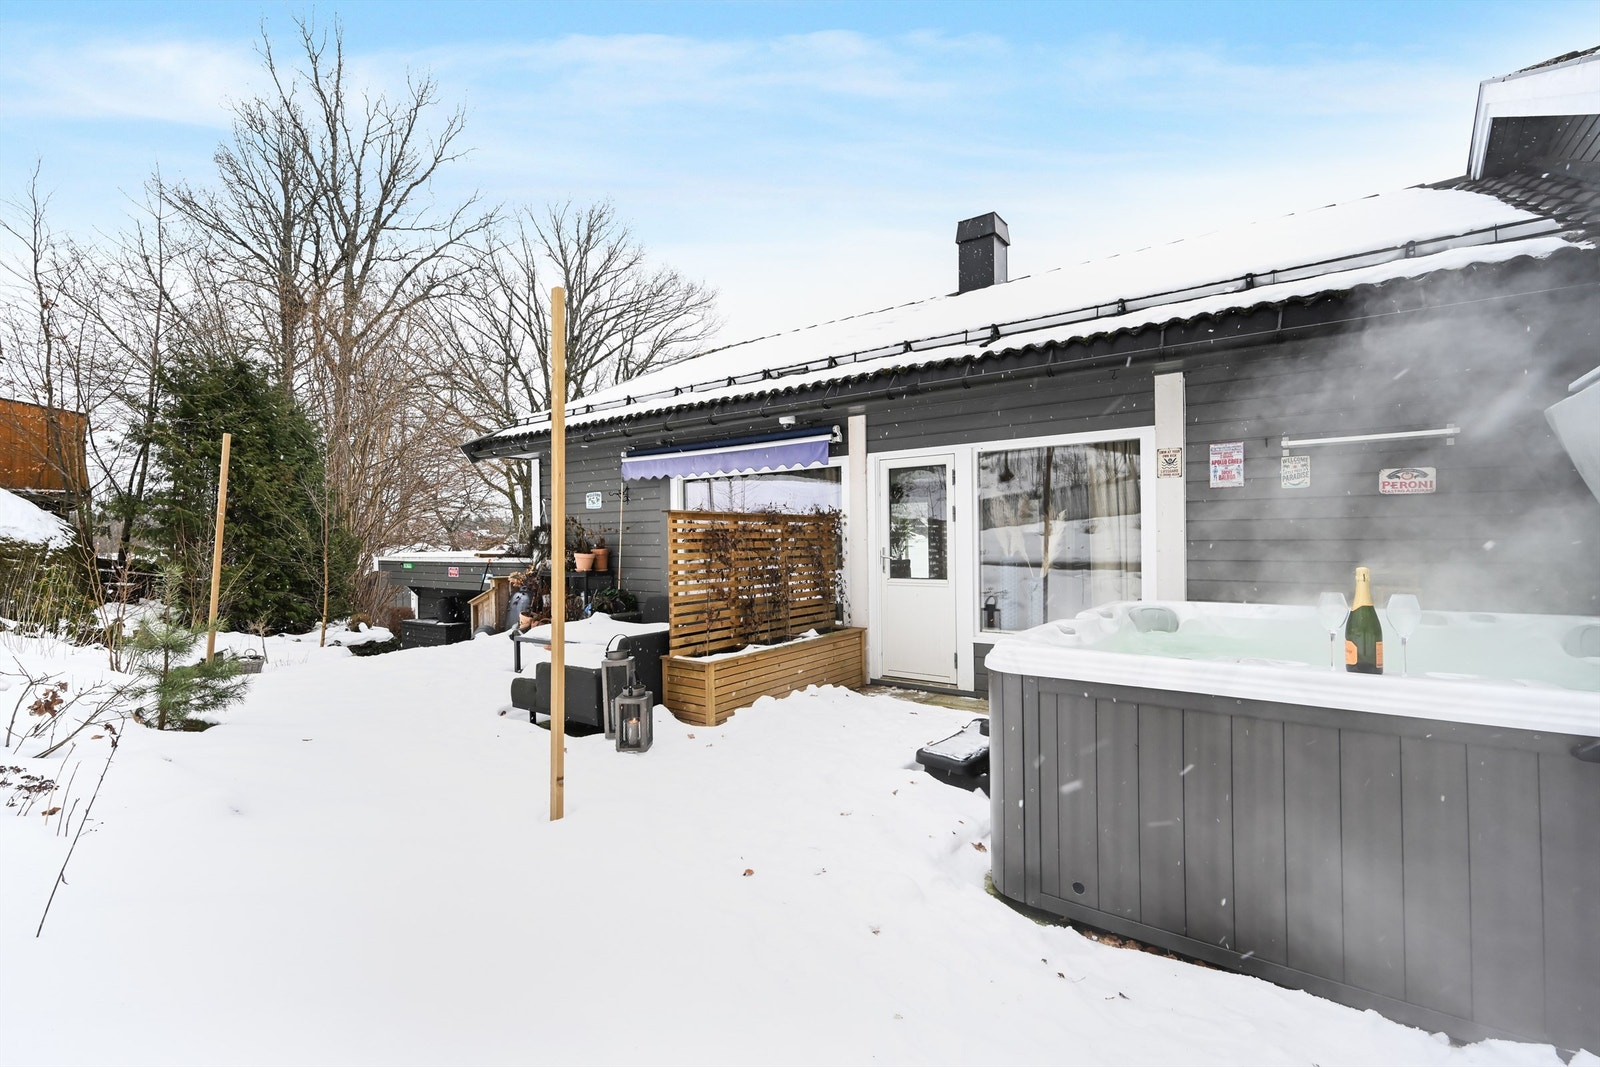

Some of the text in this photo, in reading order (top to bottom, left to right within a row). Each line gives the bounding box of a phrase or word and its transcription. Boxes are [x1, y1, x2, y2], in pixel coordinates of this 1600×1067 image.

[1282, 456, 1308, 464] WELCOME
[1282, 471, 1309, 482] PARADISE
[1381, 480, 1434, 489] PERONI
